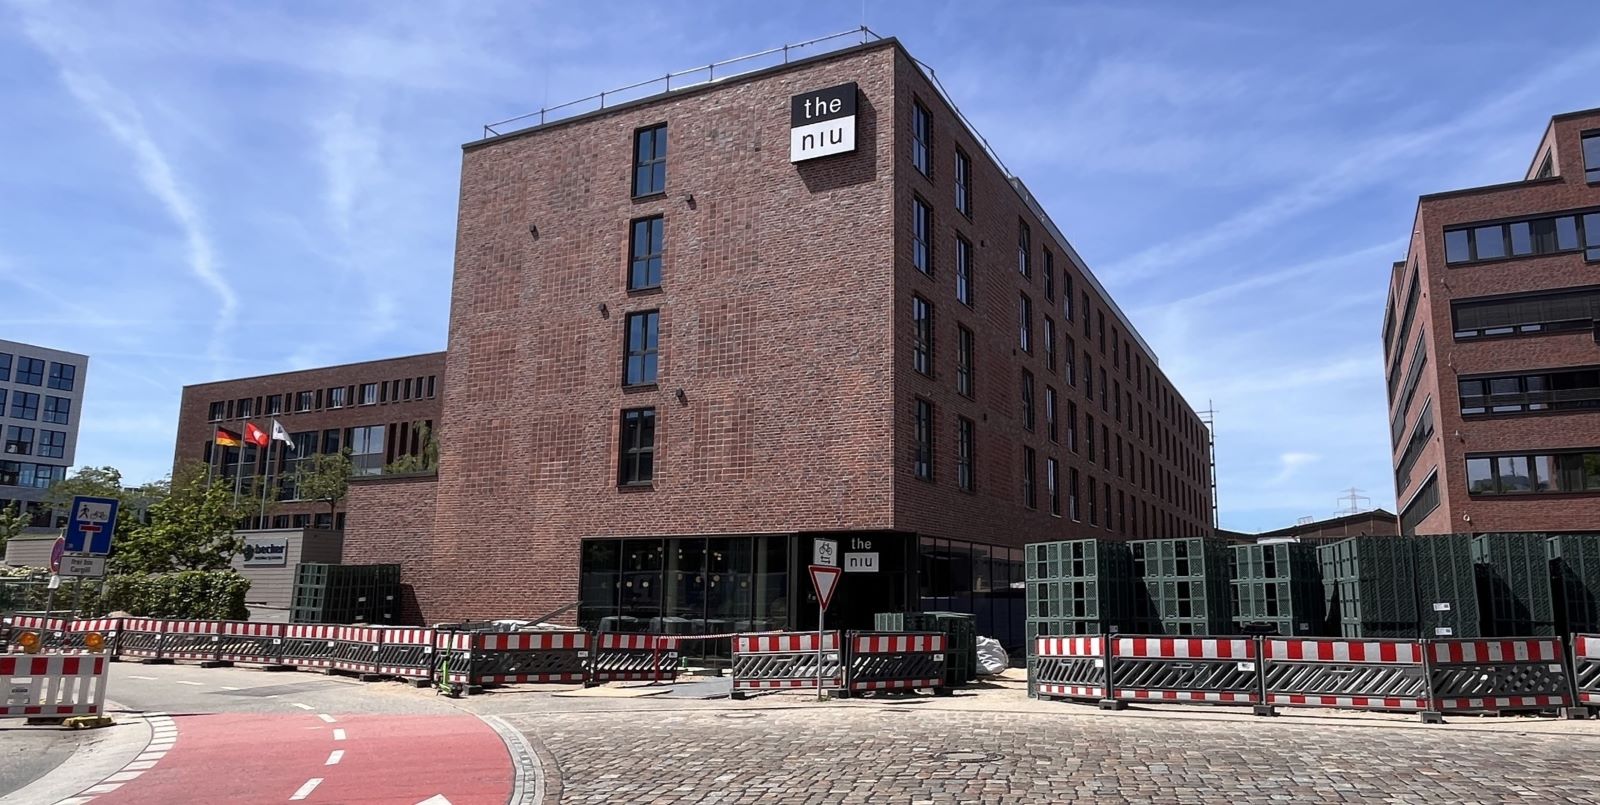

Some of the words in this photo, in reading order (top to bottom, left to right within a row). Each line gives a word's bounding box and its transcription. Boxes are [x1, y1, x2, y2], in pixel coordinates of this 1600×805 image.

[804, 97, 841, 118] the
[802, 128, 842, 150] niu
[851, 538, 872, 549] the
[850, 557, 872, 567] niu
